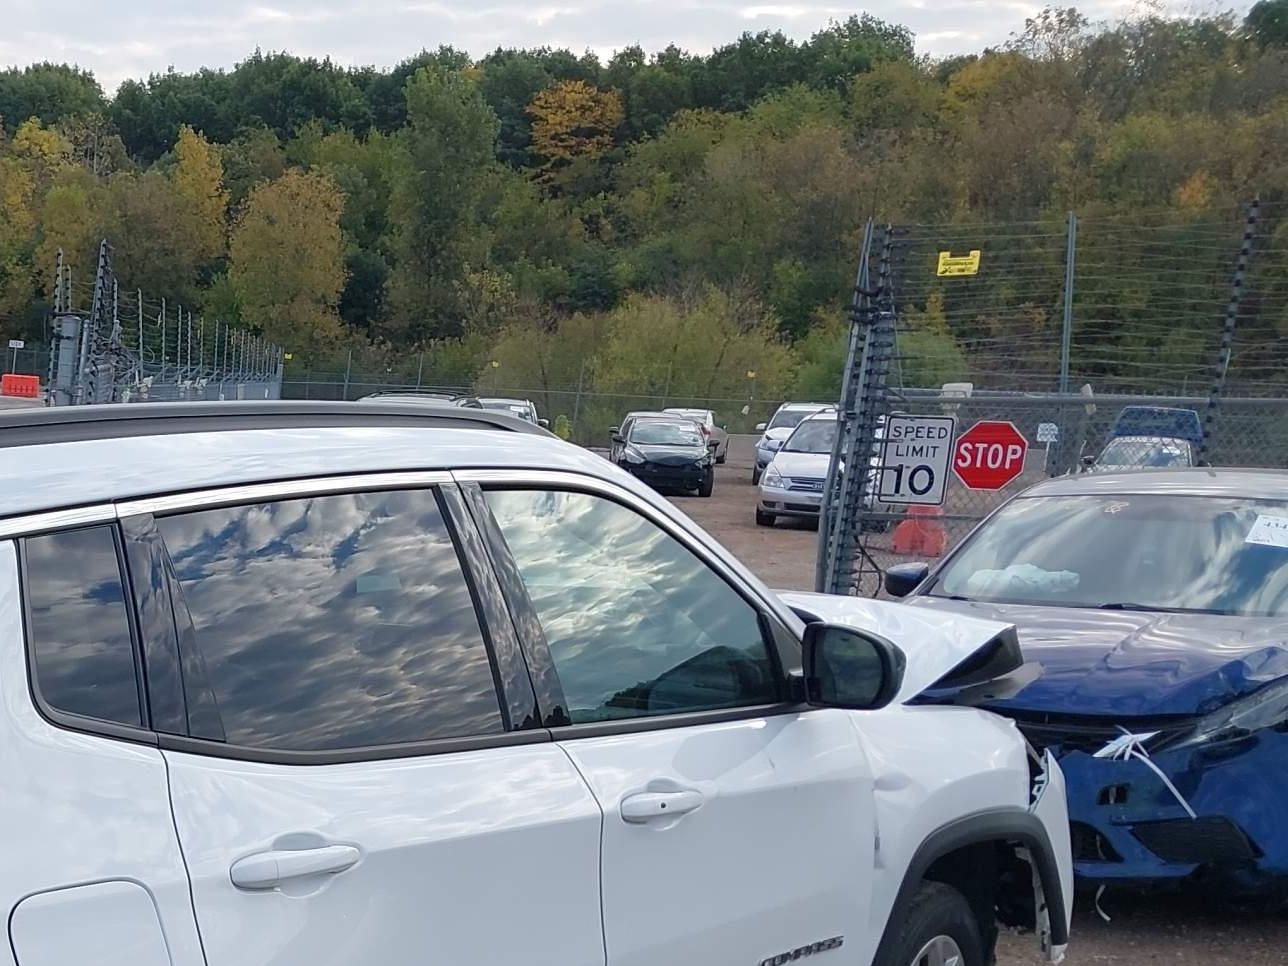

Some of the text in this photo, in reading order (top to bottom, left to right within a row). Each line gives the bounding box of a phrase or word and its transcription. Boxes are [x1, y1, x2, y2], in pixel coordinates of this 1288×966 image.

[892, 425, 948, 440] SPEED
[895, 445, 940, 458] LIMIT
[957, 442, 1023, 470] STOP
[893, 464, 935, 496] 10
